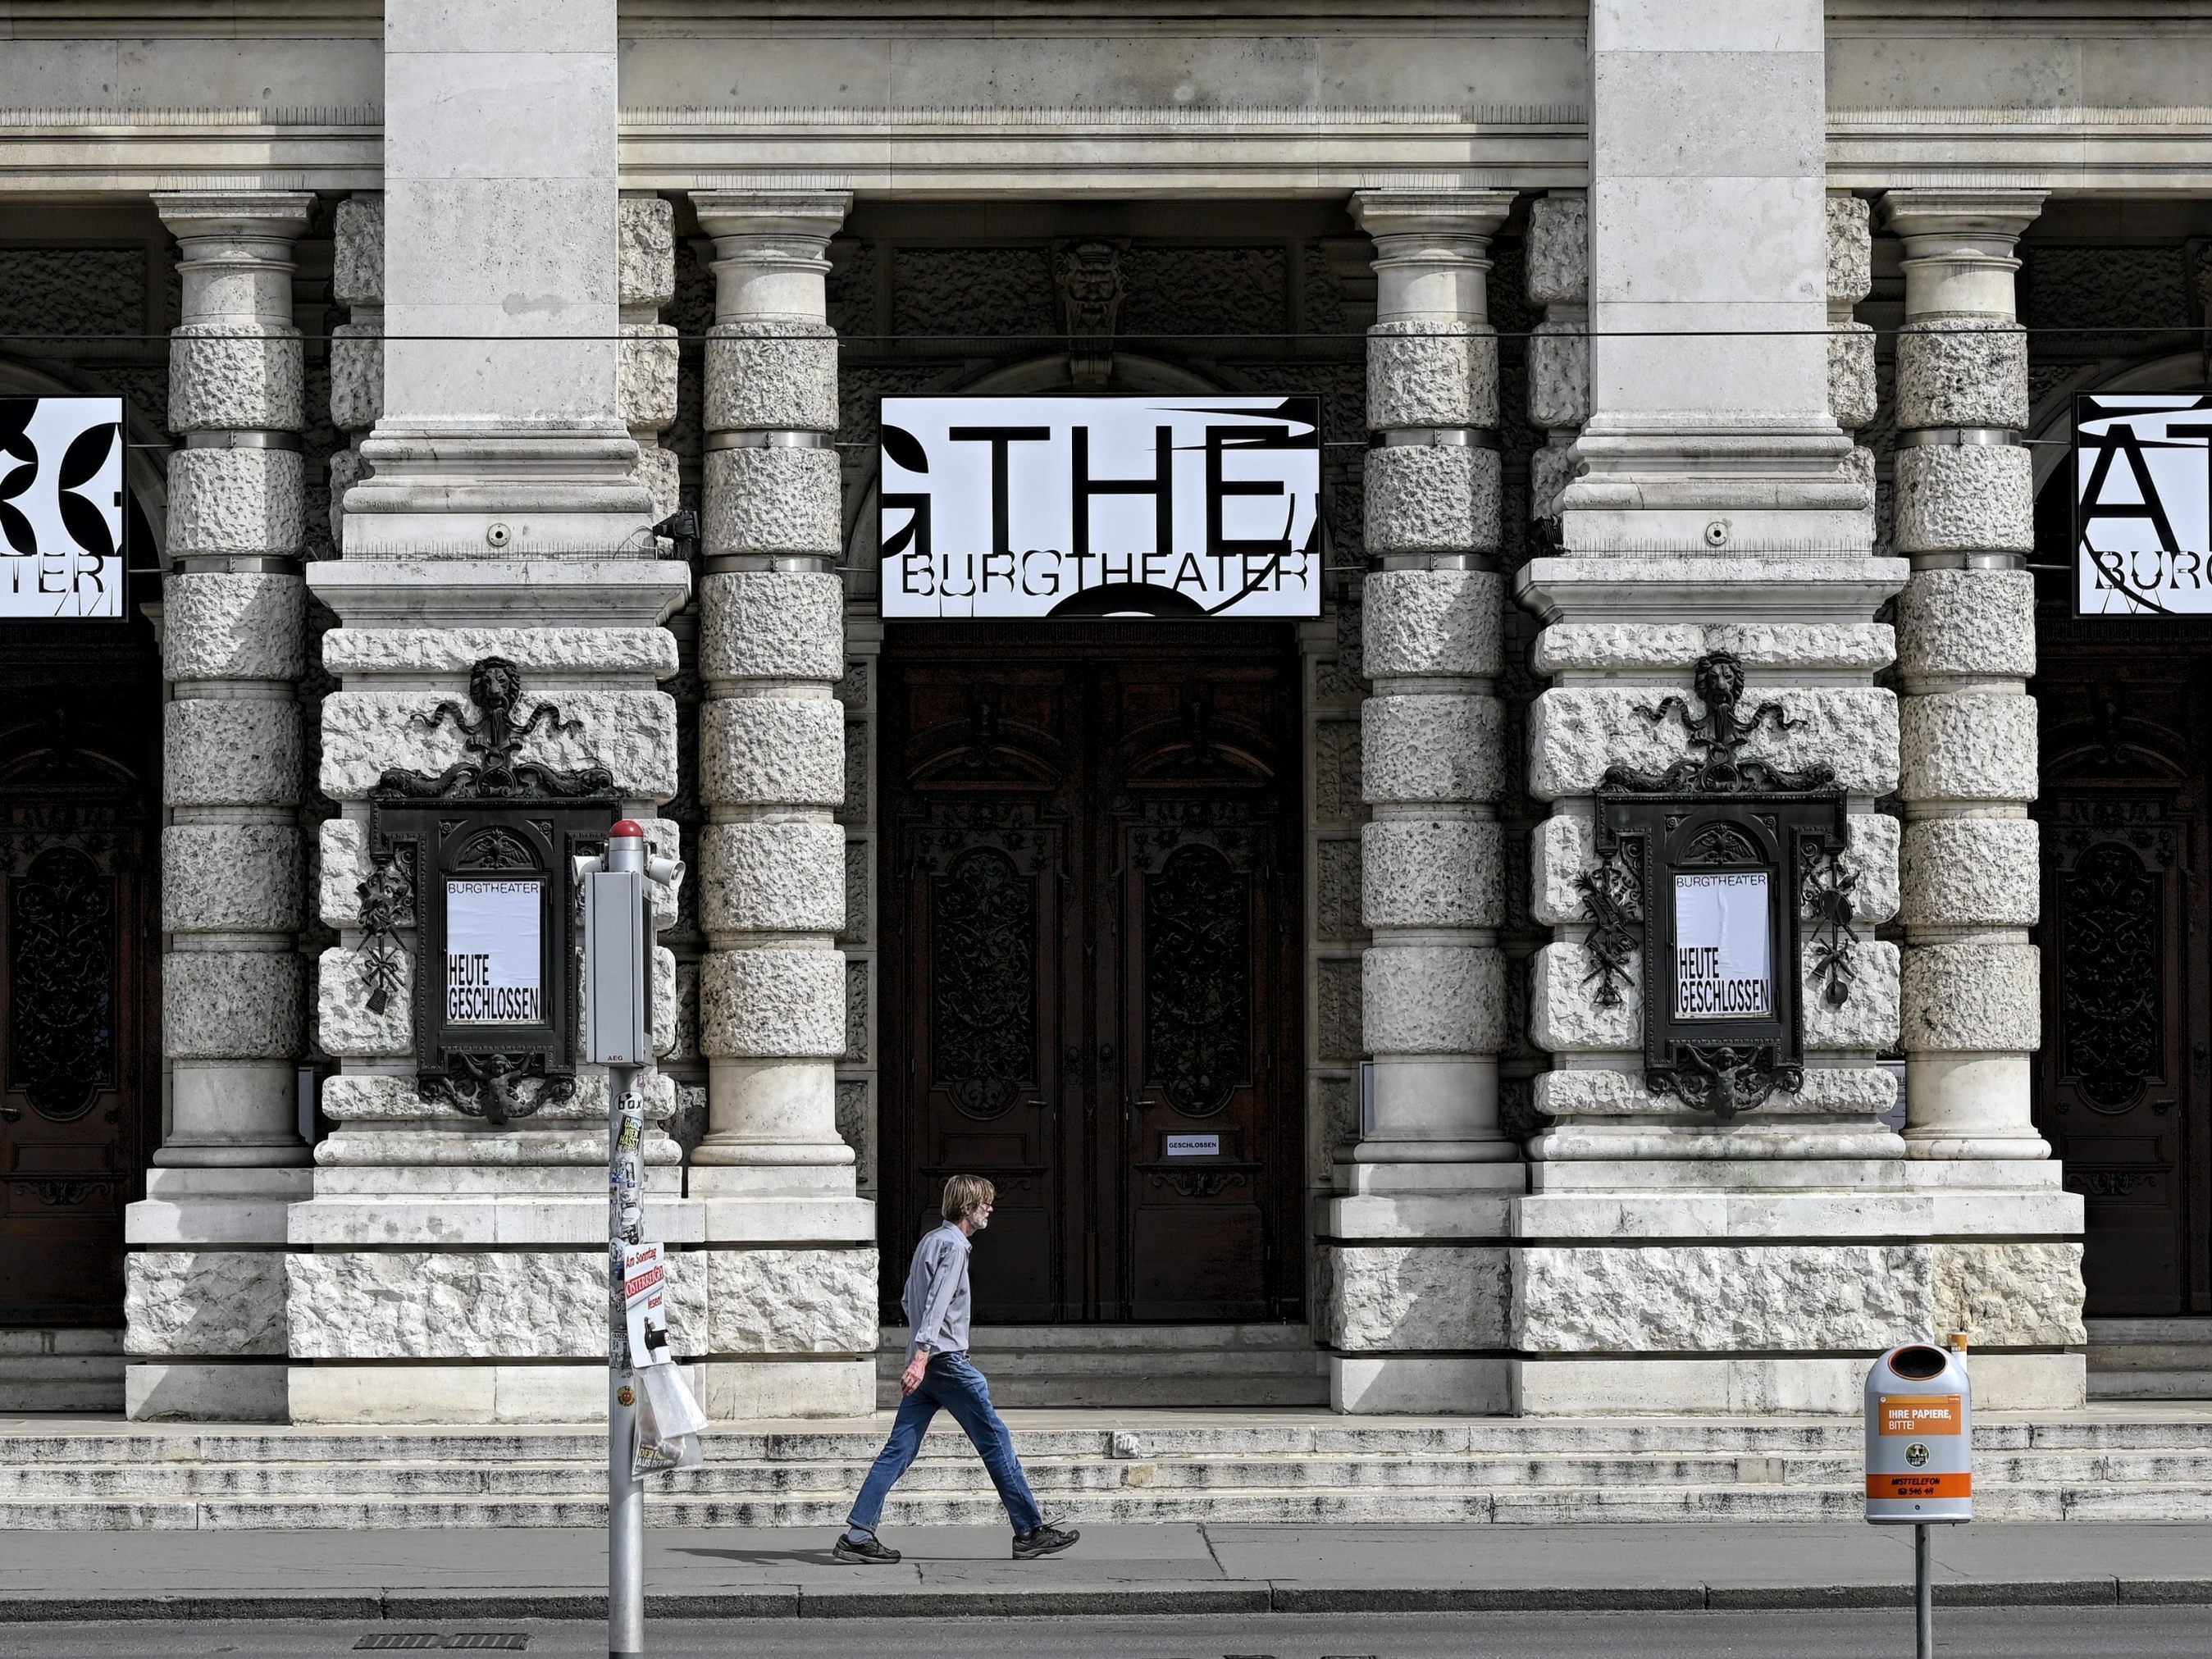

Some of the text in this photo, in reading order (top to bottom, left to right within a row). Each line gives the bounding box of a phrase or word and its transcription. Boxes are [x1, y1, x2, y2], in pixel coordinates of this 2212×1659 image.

[901, 549, 1308, 597] BURGTHEATER
[2095, 550, 2212, 590] BUR
[448, 882, 539, 894] BURGTHEATER
[1676, 875, 1766, 888] BURGTHEATER
[449, 954, 490, 986] HEUTE
[1679, 947, 1719, 979] HEUTE
[449, 987, 539, 1019] GESCHLOSSEN
[1681, 979, 1769, 1013] GESCHLOSSEN
[636, 1247, 658, 1265] Sonntag
[1889, 1409, 1952, 1420] IHRE PAPIERE,
[1889, 1420, 1915, 1430] BITTE!
[638, 1447, 654, 1459] DER
[636, 1458, 652, 1468] AUS
[1891, 1477, 1941, 1486] MISTTELEFON
